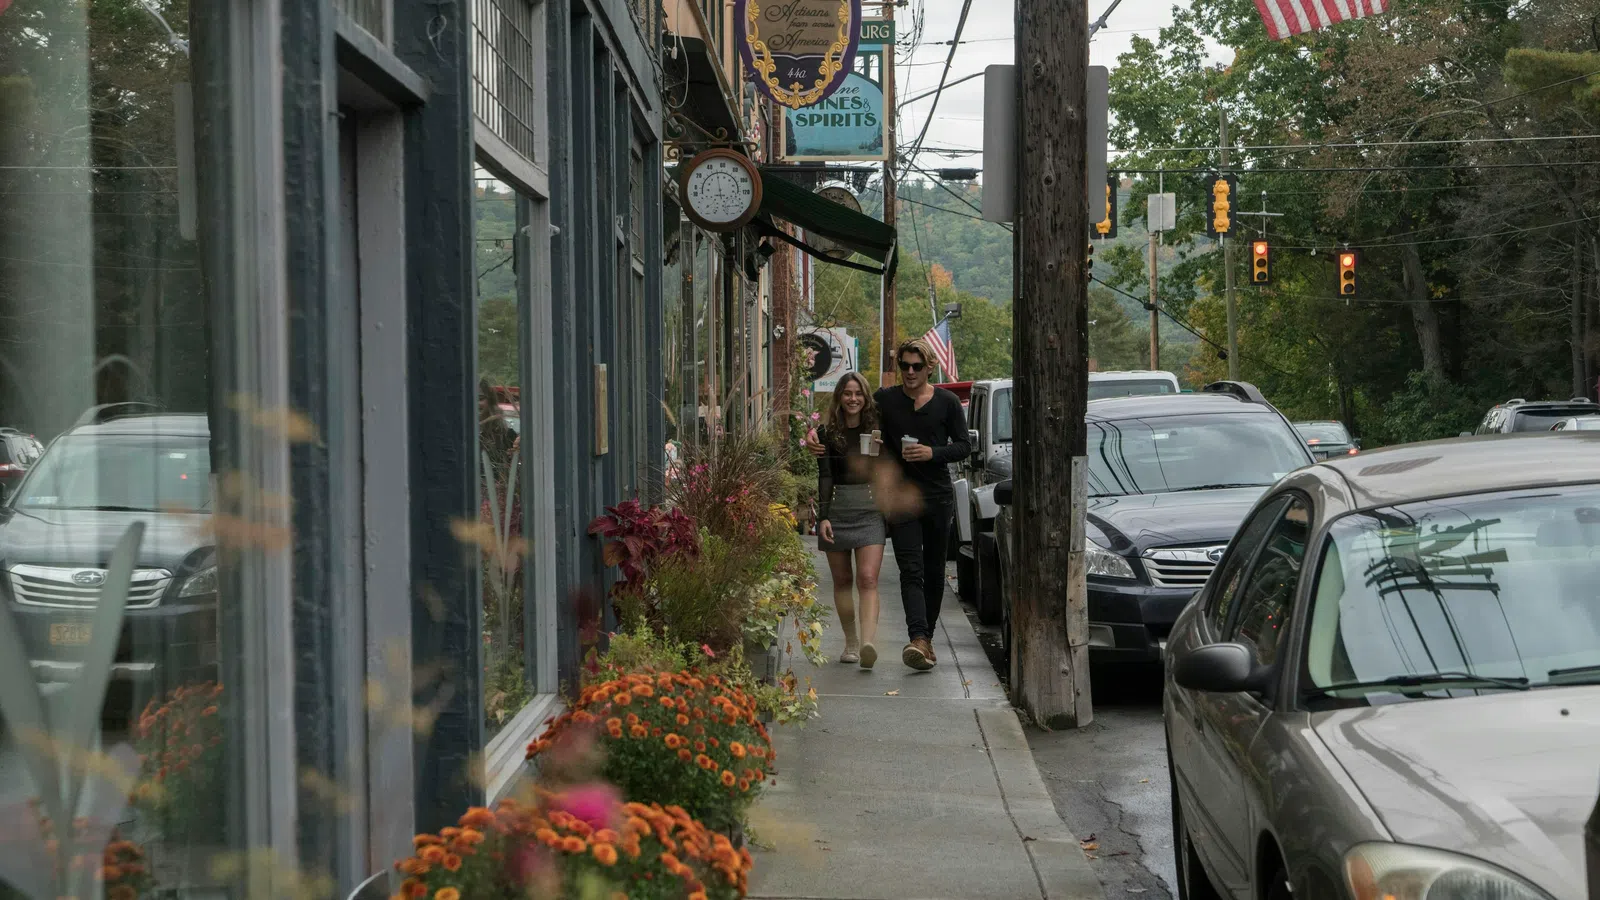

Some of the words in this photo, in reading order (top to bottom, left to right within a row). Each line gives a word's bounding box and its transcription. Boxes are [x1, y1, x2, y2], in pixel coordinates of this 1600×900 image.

[764, 0, 829, 22] Artisans
[786, 17, 808, 30] from
[768, 29, 829, 50] America
[787, 67, 808, 79] 44a
[795, 112, 877, 127] SPIRITS
